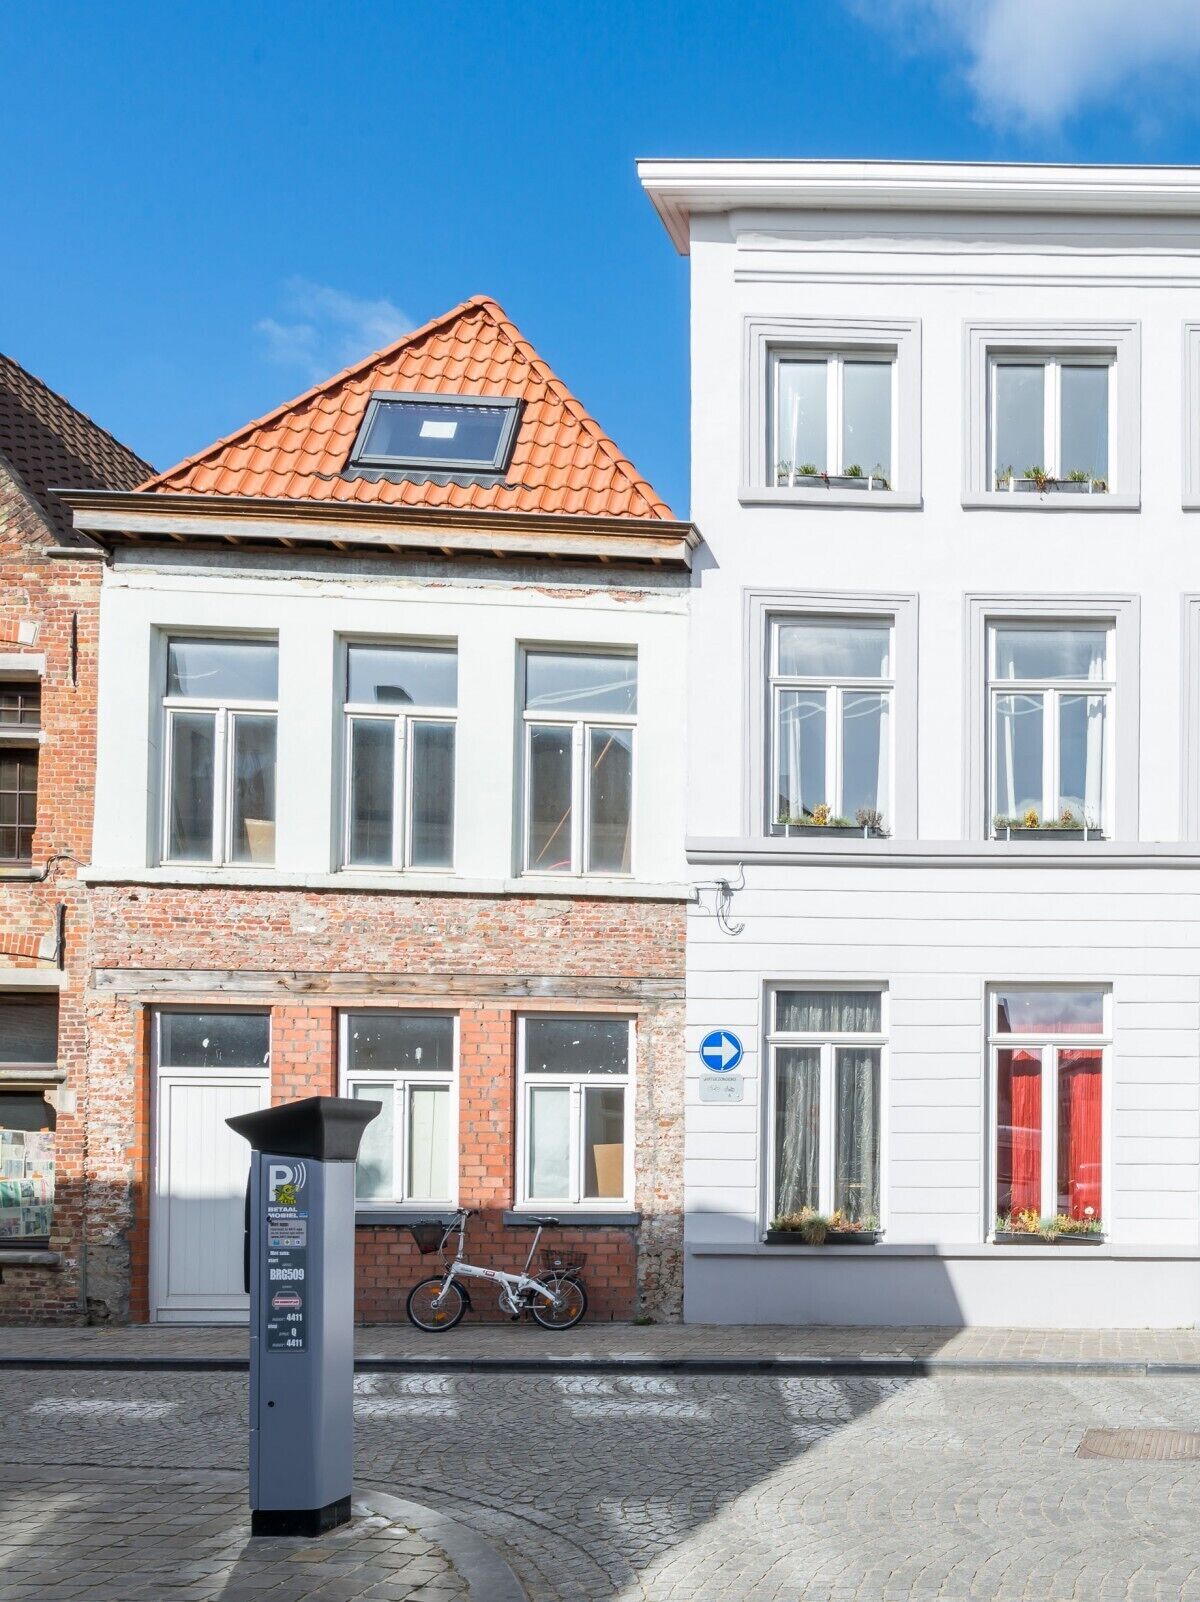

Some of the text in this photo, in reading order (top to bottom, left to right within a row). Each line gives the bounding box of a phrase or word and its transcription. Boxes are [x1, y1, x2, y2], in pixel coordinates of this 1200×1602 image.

[269, 1165, 294, 1202] P
[269, 1268, 305, 1281] BRG509
[286, 1313, 303, 1322] 4411
[286, 1339, 303, 1347] 4411
